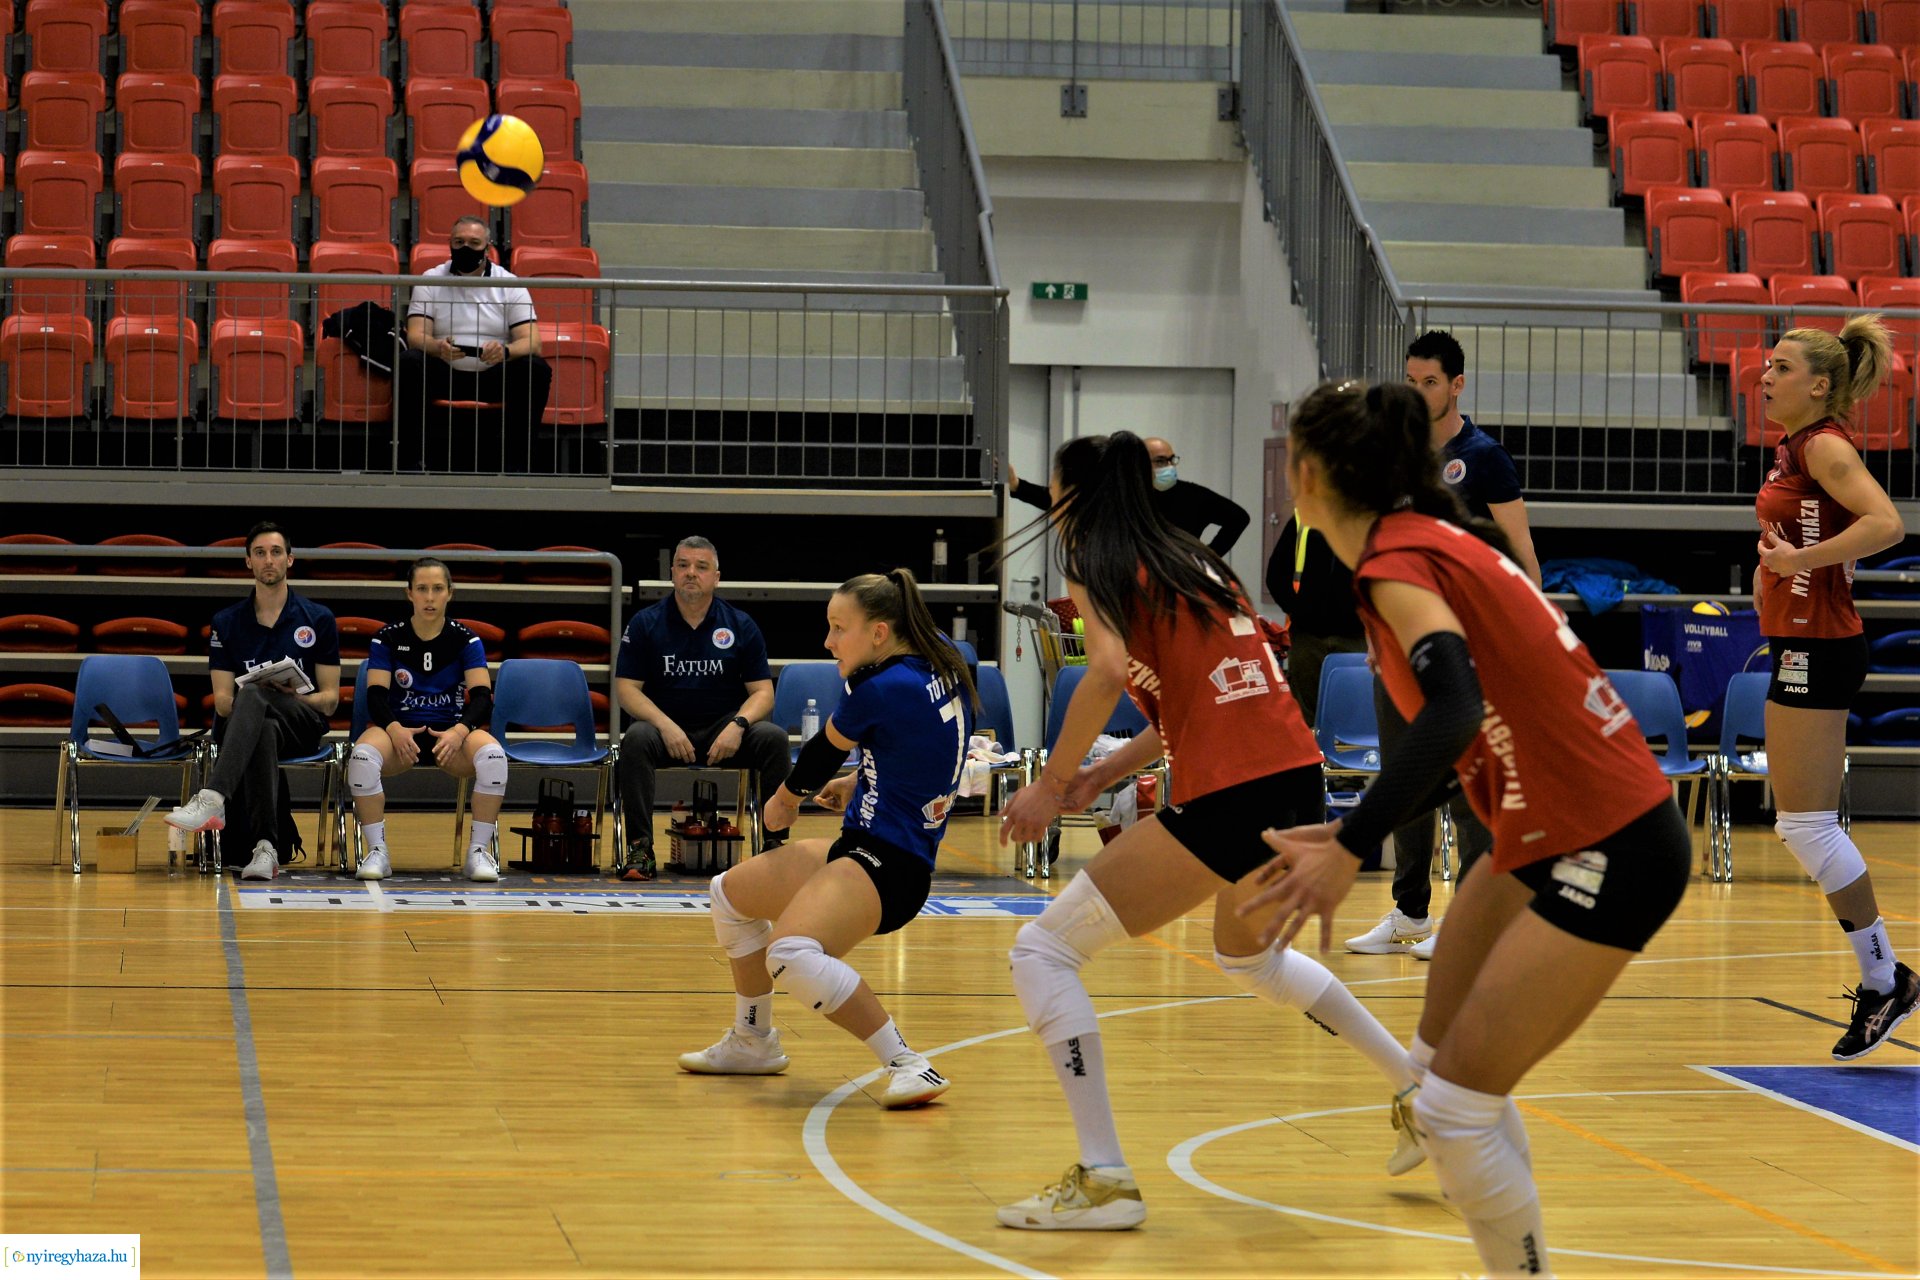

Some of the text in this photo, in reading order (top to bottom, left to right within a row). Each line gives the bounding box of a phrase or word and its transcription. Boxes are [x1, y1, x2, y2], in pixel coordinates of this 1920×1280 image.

[1684, 623, 1728, 637] VOLLEYBALL
[423, 651, 433, 671] 8
[662, 653, 725, 674] FATUM
[1784, 684, 1809, 694] JAKO
[938, 695, 965, 785] 7
[1870, 932, 1884, 961] MIKASA
[744, 1004, 758, 1026] MIKASA
